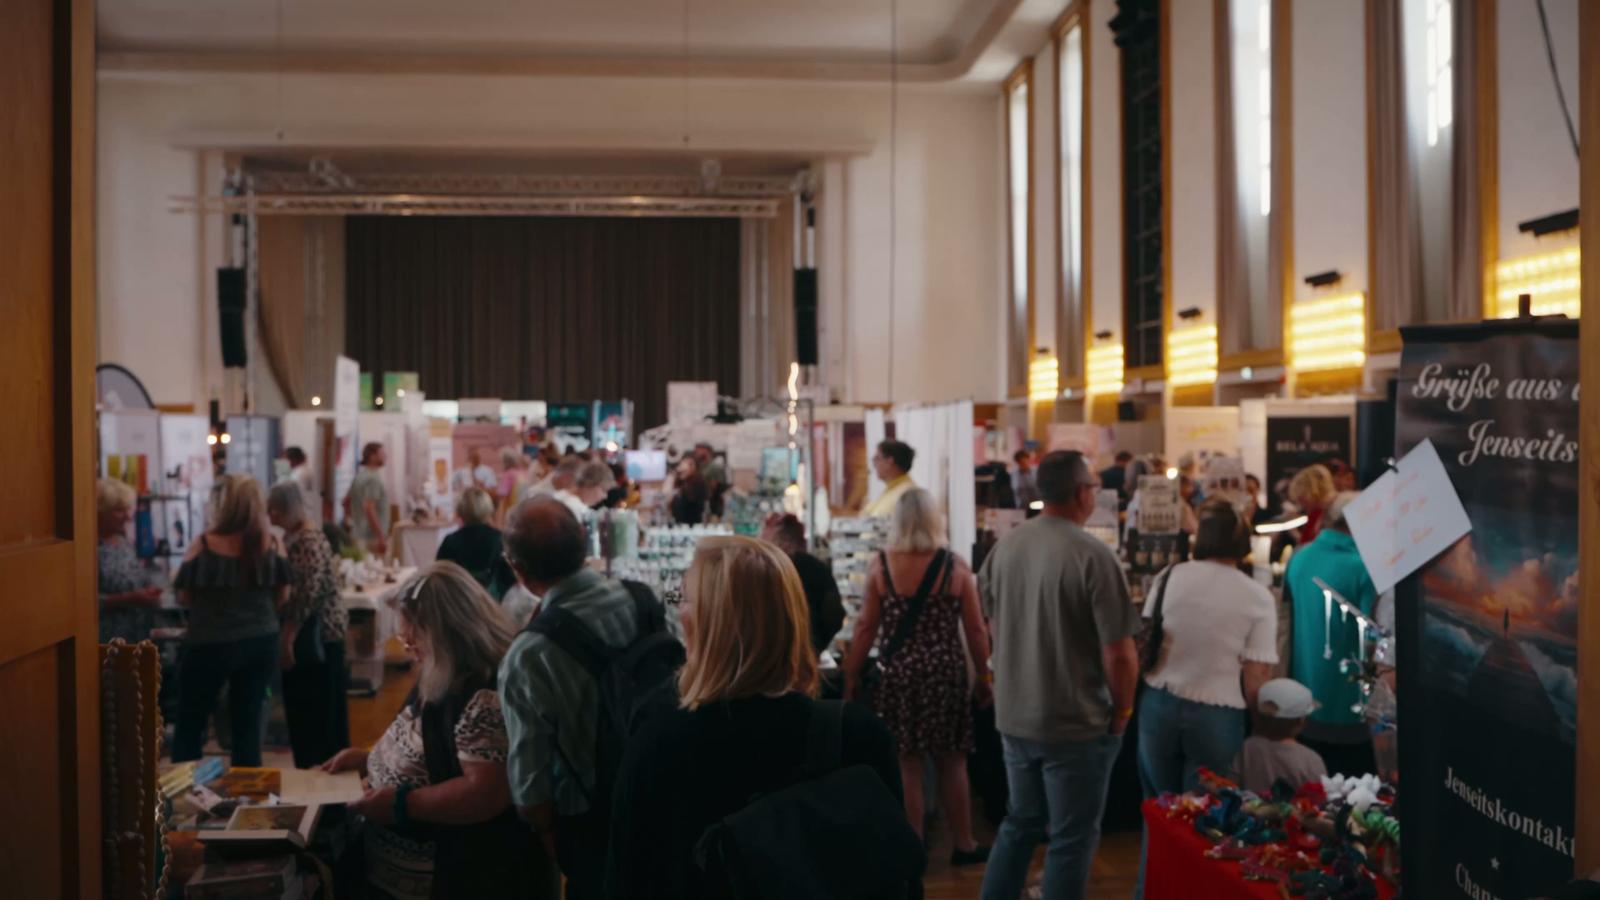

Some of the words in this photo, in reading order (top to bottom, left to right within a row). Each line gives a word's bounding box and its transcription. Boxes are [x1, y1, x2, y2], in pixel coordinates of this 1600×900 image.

[1412, 363, 1499, 412] Grüße
[1507, 378, 1562, 400] aus
[1458, 420, 1578, 466] Jenseits
[1456, 863, 1501, 900] Chan
